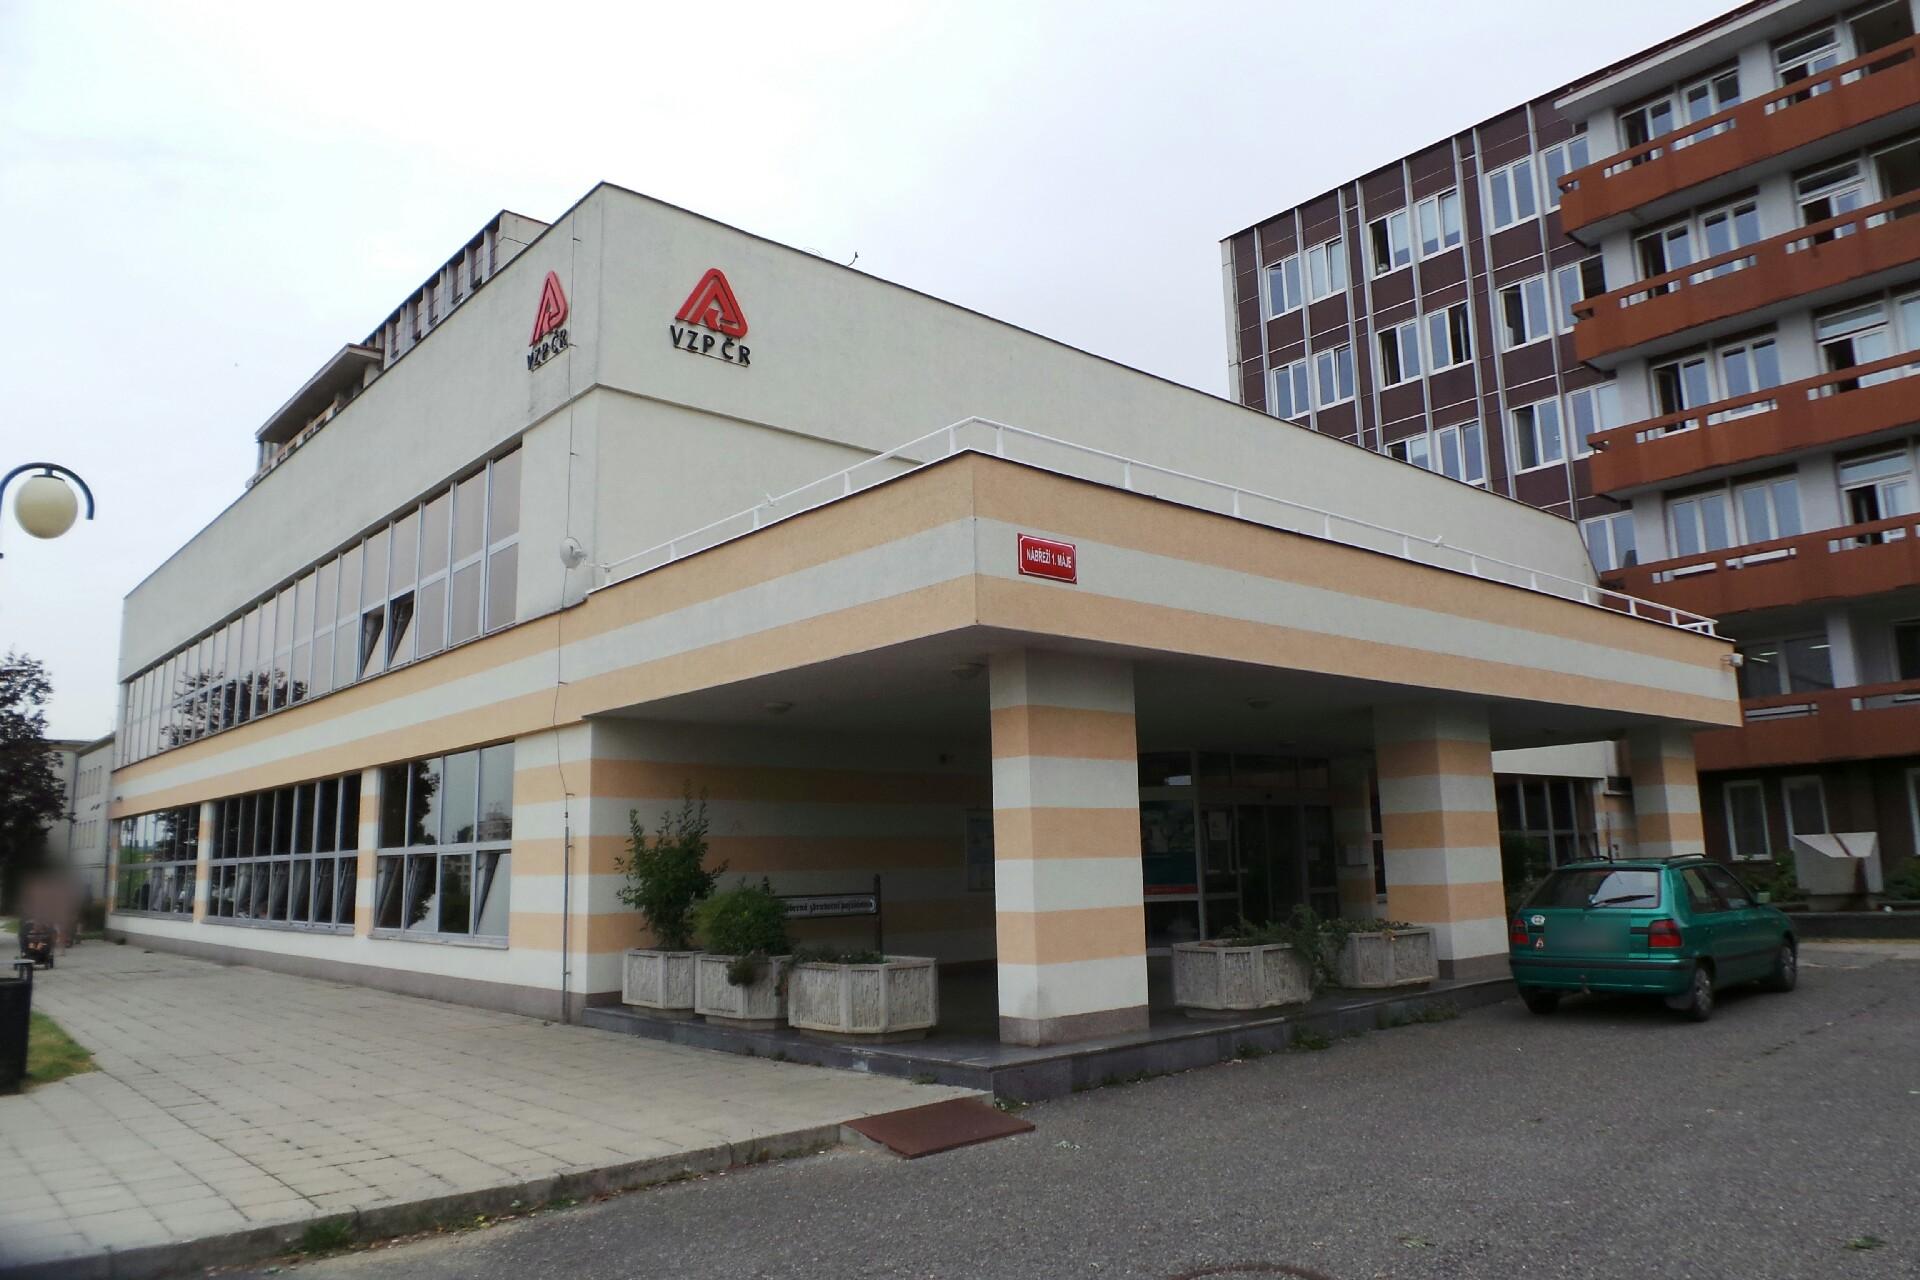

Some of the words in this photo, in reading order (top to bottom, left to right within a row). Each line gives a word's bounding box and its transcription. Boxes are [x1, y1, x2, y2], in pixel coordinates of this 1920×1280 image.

[670, 325, 715, 354] VZP
[721, 337, 751, 365] ČR
[1026, 546, 1051, 564] NÁBŘEŽÍ
[1051, 553, 1057, 566] 1.
[1057, 552, 1072, 569] MÁJE
